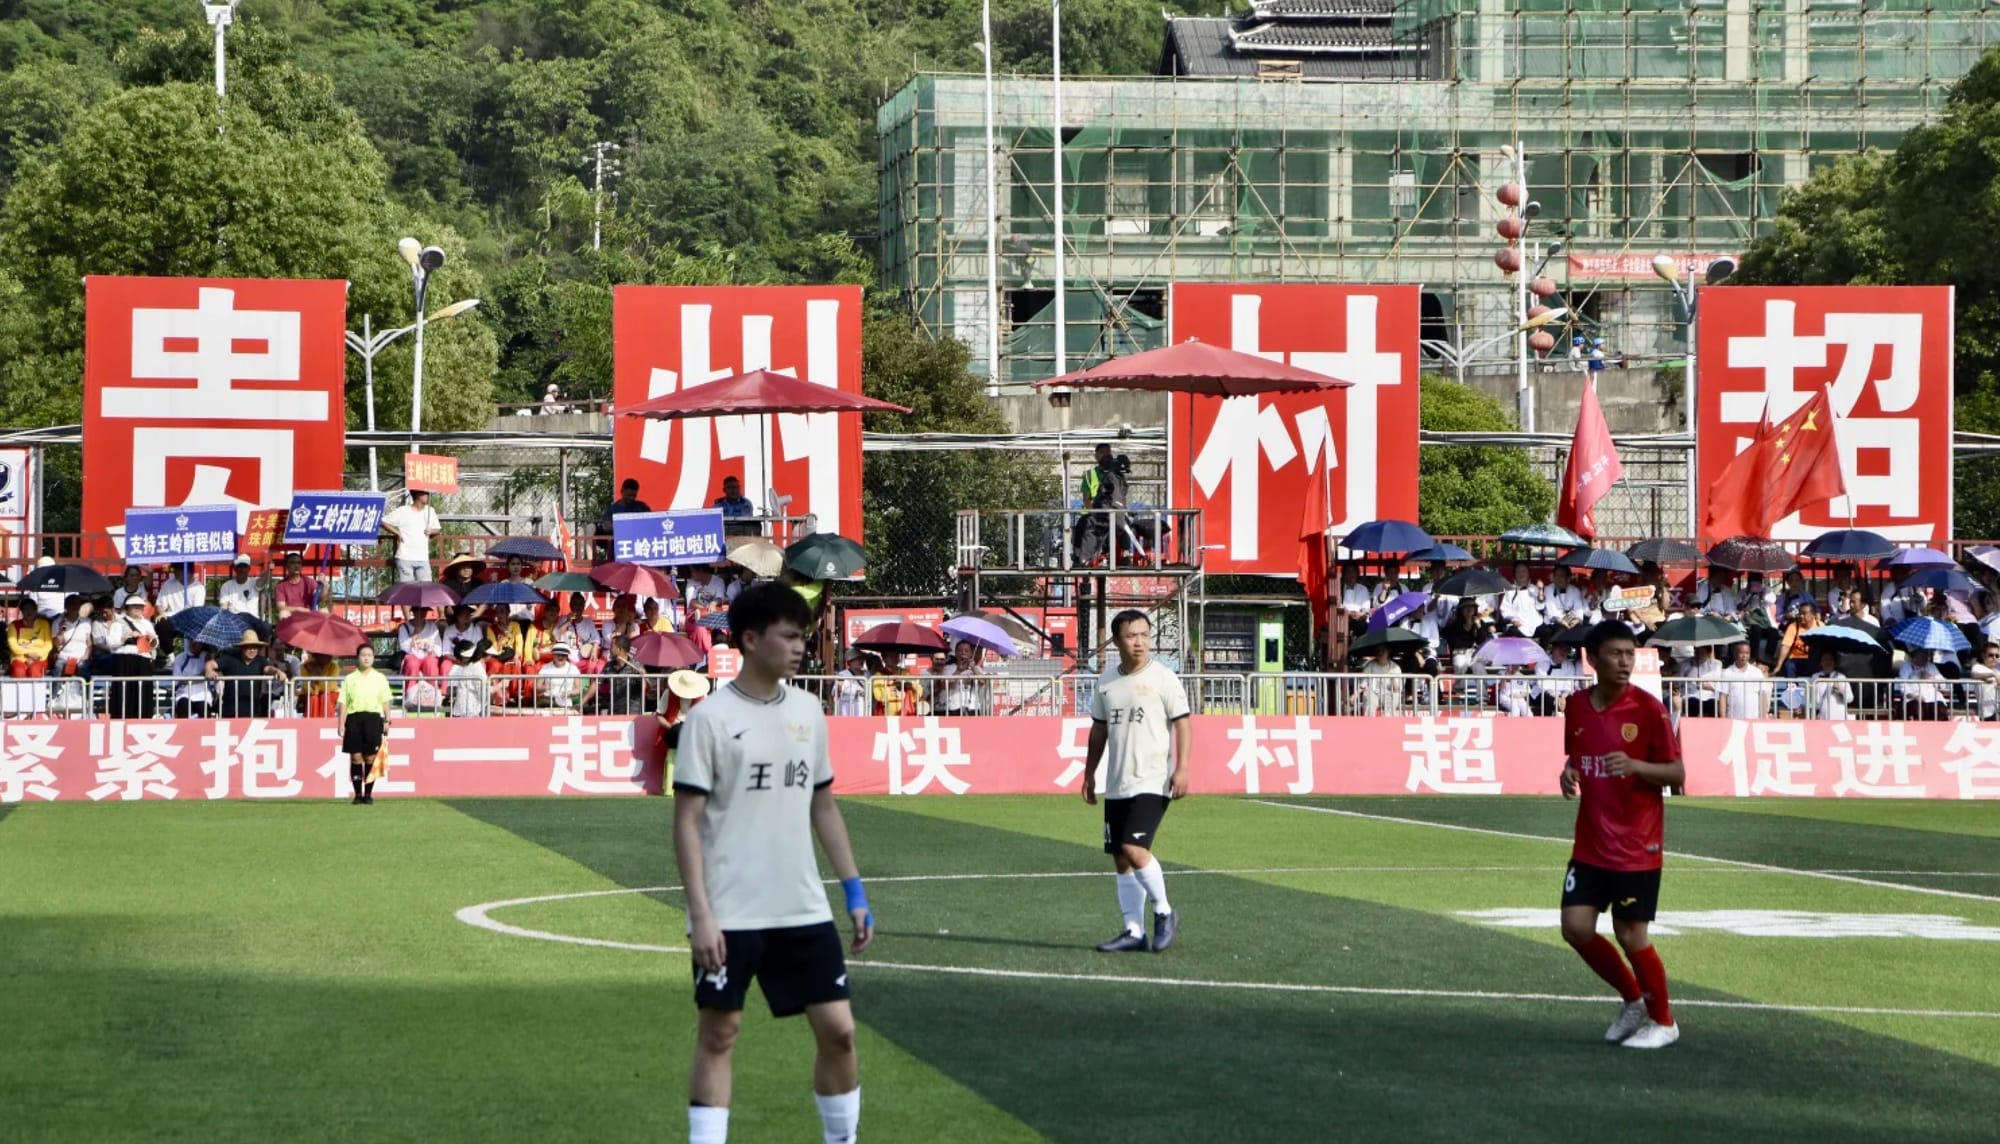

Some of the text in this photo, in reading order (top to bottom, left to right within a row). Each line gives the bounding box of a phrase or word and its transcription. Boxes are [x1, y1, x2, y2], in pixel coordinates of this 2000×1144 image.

[101, 287, 329, 560] 贵
[640, 299, 840, 550] 州
[1191, 294, 1401, 561] 村
[1720, 299, 1936, 560] 超
[407, 460, 456, 485] 王岭村足球队
[130, 529, 236, 556] 支持王岭前程似锦
[616, 532, 722, 559] 王岭村啦啦队
[1111, 706, 1145, 725] 王岭
[746, 759, 810, 792] 王岭
